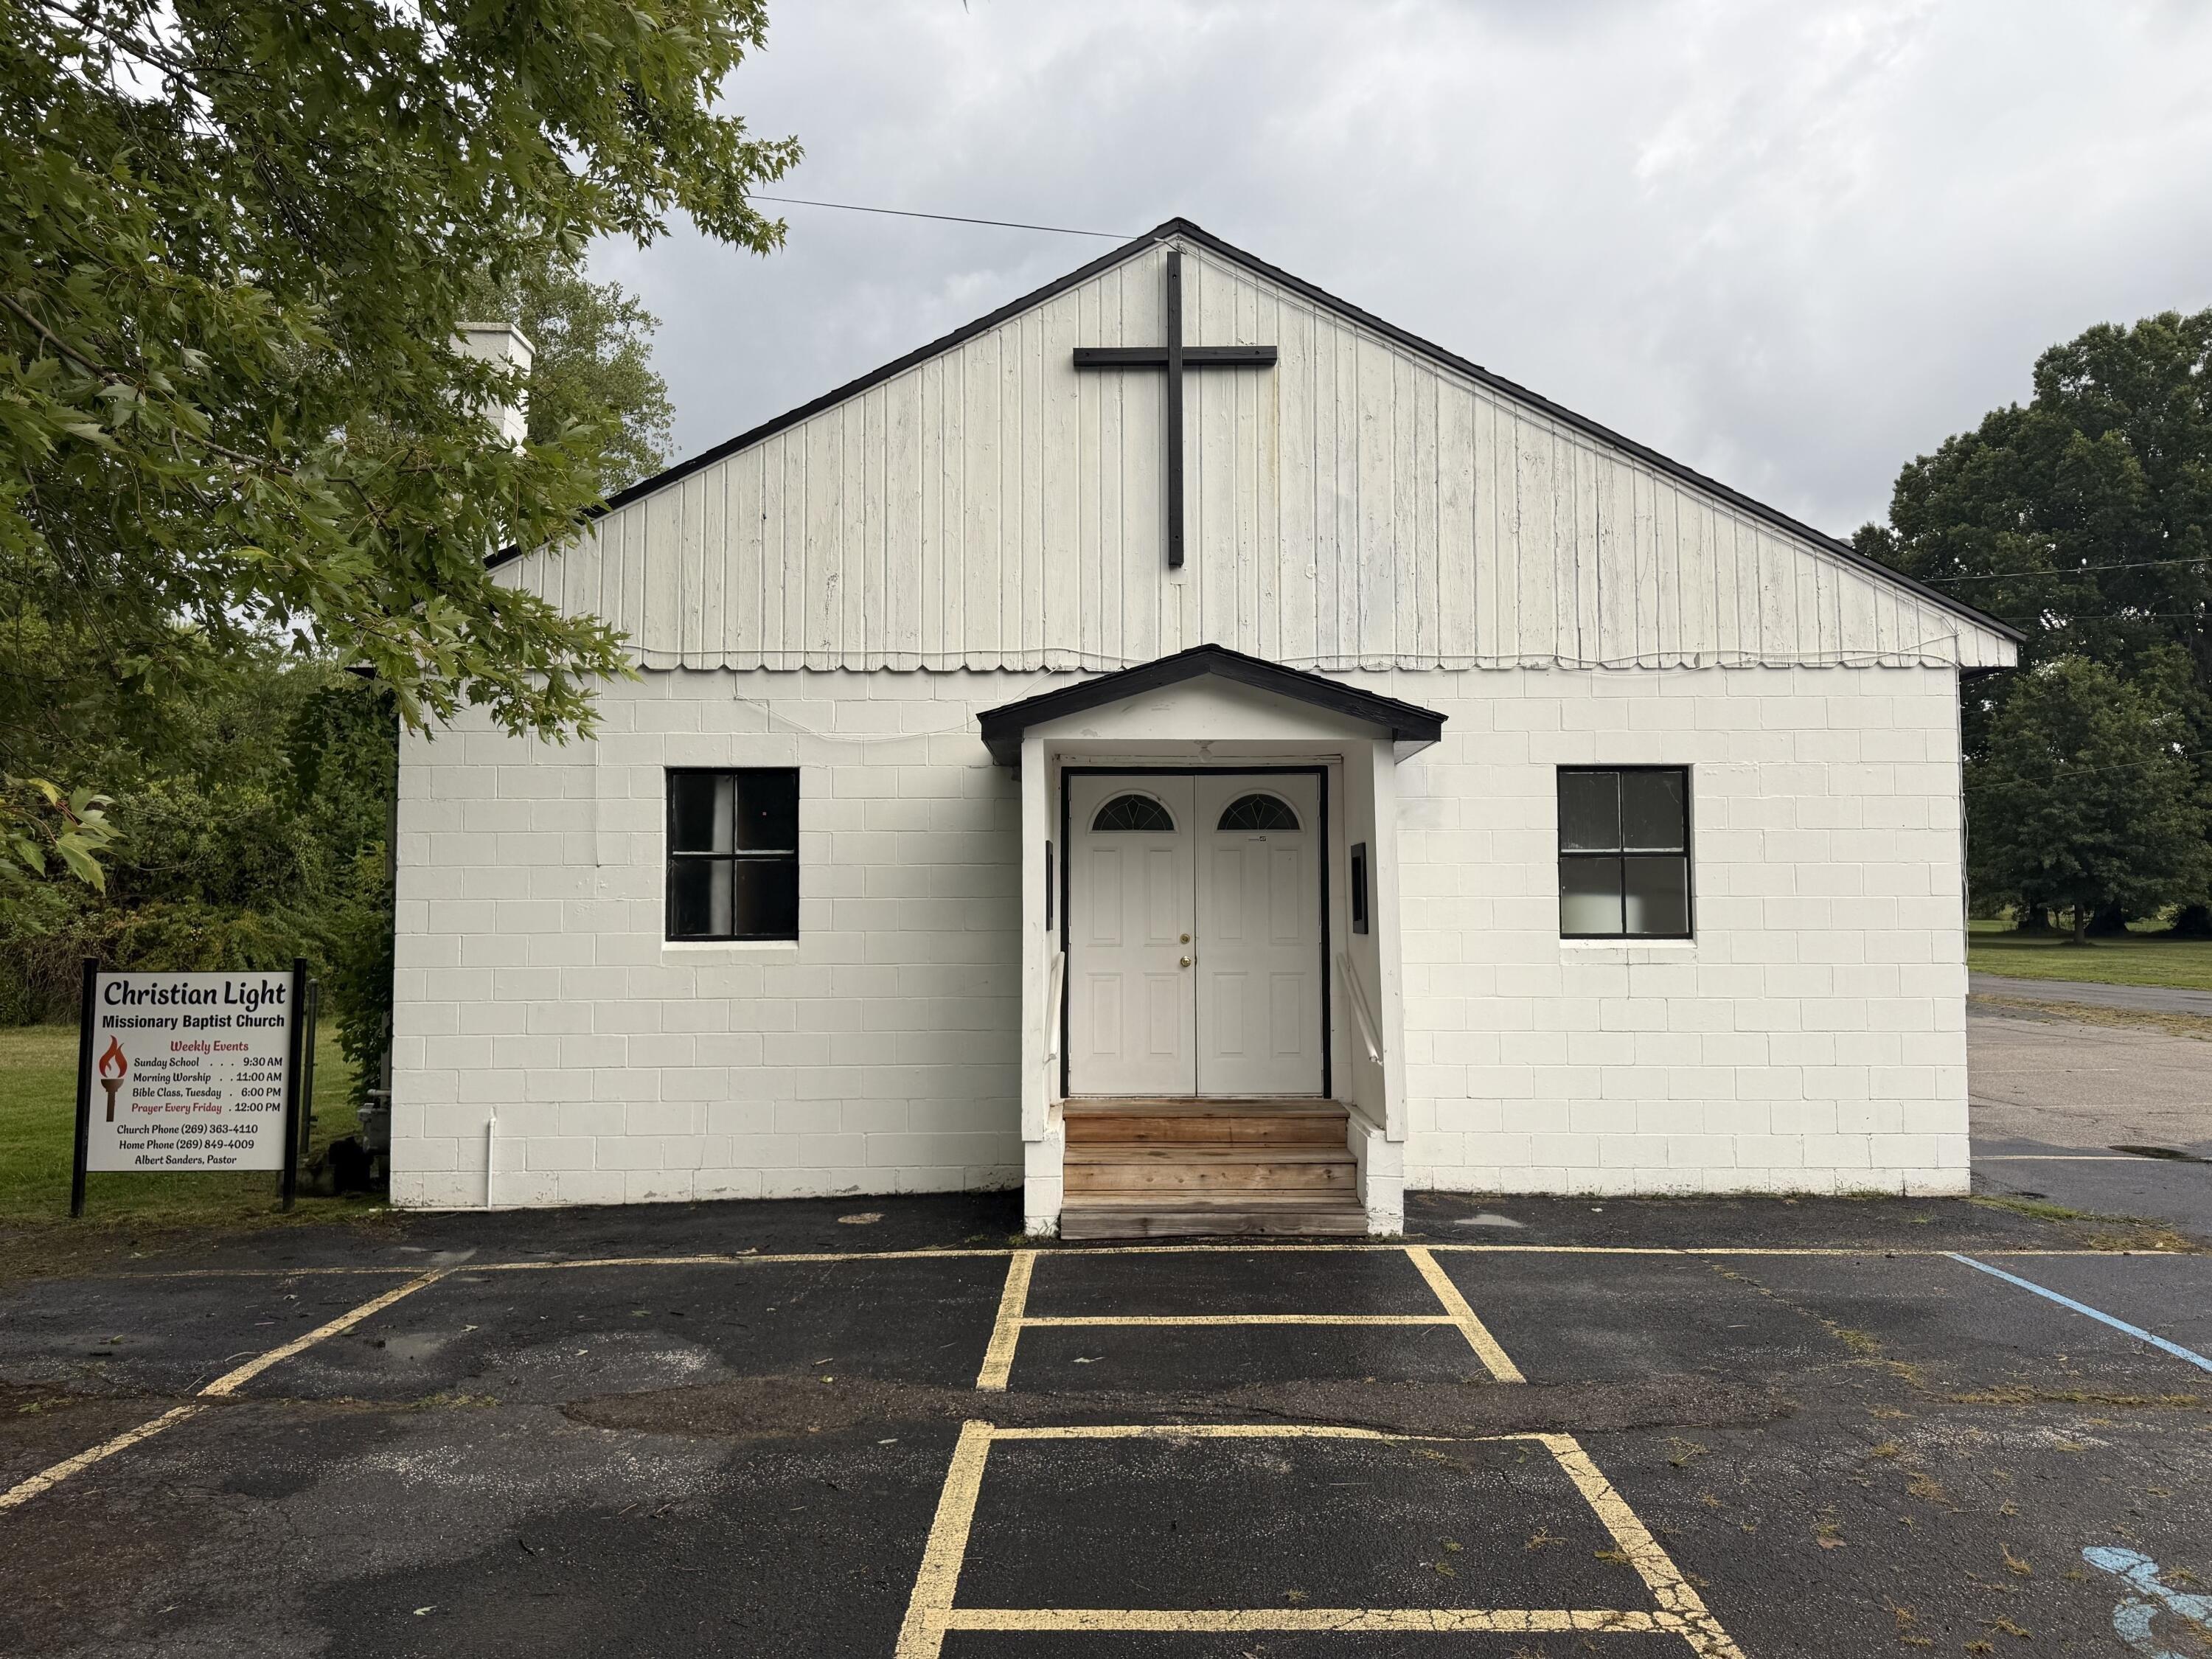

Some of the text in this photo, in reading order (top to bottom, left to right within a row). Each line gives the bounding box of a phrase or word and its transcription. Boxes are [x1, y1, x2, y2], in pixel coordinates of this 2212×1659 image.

[104, 980, 286, 1012] Christian Light
[102, 1015, 285, 1030] Missionary Baptist Church
[170, 1040, 248, 1054] Weekly Events
[134, 1057, 282, 1069] Sunday School 9:30 AM
[133, 1073, 282, 1084] Morning Worship 11:00 AM
[133, 1088, 281, 1099] Bible Class, Tuesday 6:00 PM
[131, 1103, 280, 1114] Prayer Every Friday 12:00 PM
[116, 1124, 258, 1135] Church Phone (269) 363-4110
[119, 1139, 254, 1150] Home Phone (269) 849-4009
[135, 1155, 237, 1165] Albert Sanders, Pastor
